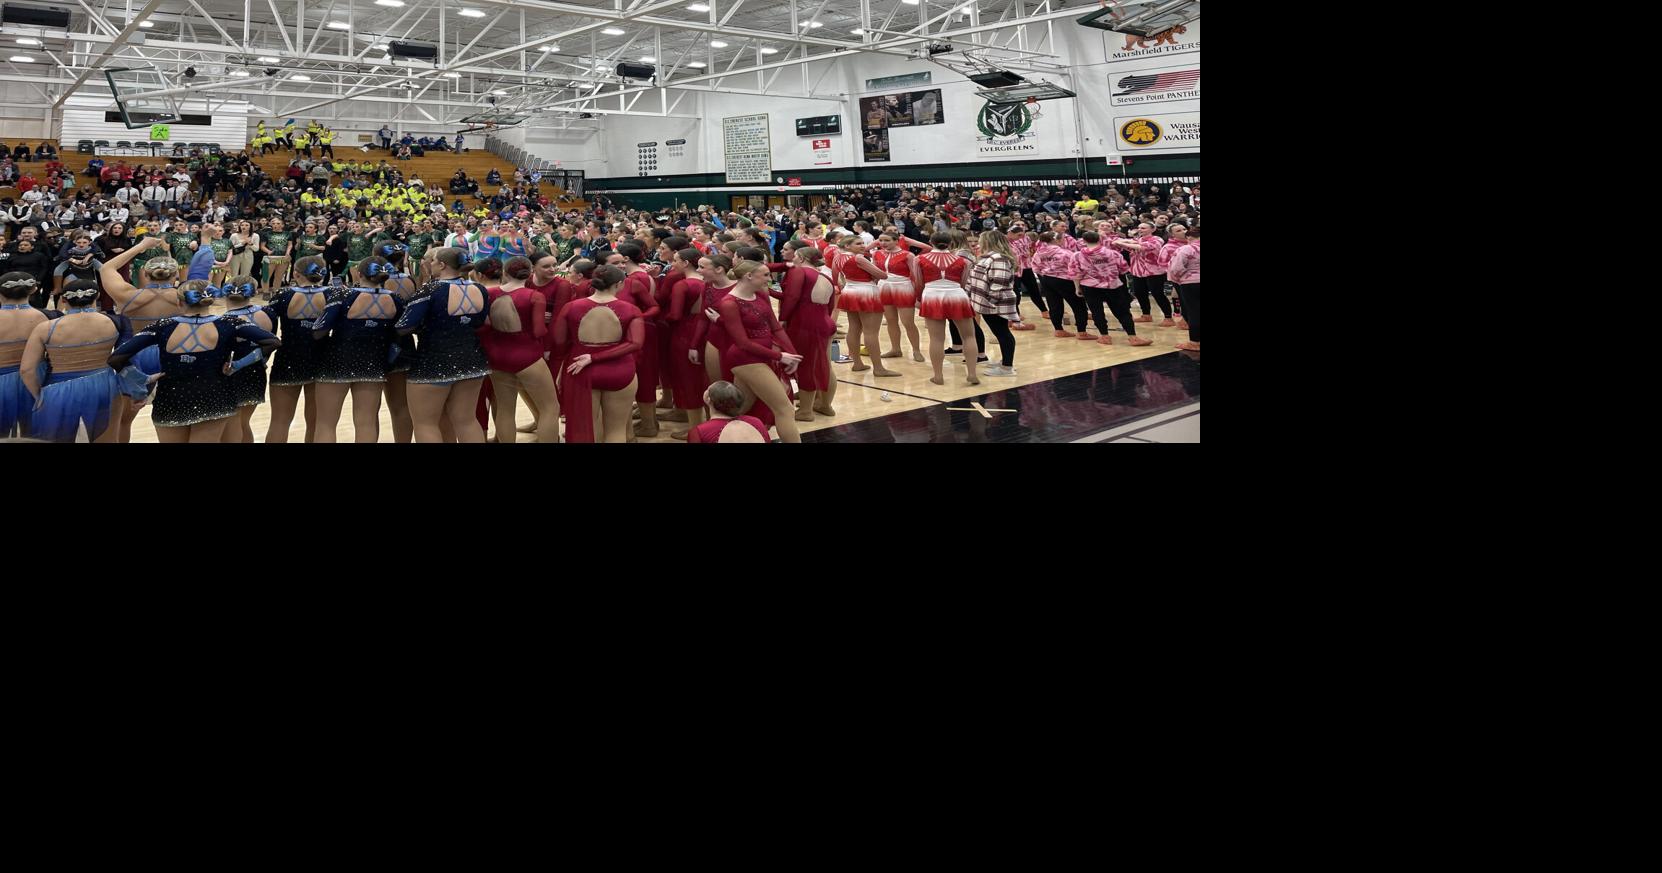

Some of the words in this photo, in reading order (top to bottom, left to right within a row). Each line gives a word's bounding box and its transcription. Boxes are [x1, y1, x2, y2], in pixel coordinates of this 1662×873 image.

[1113, 47, 1162, 59] Marshfield
[1163, 42, 1200, 52] TIGERS
[1117, 96, 1144, 104] Stevens
